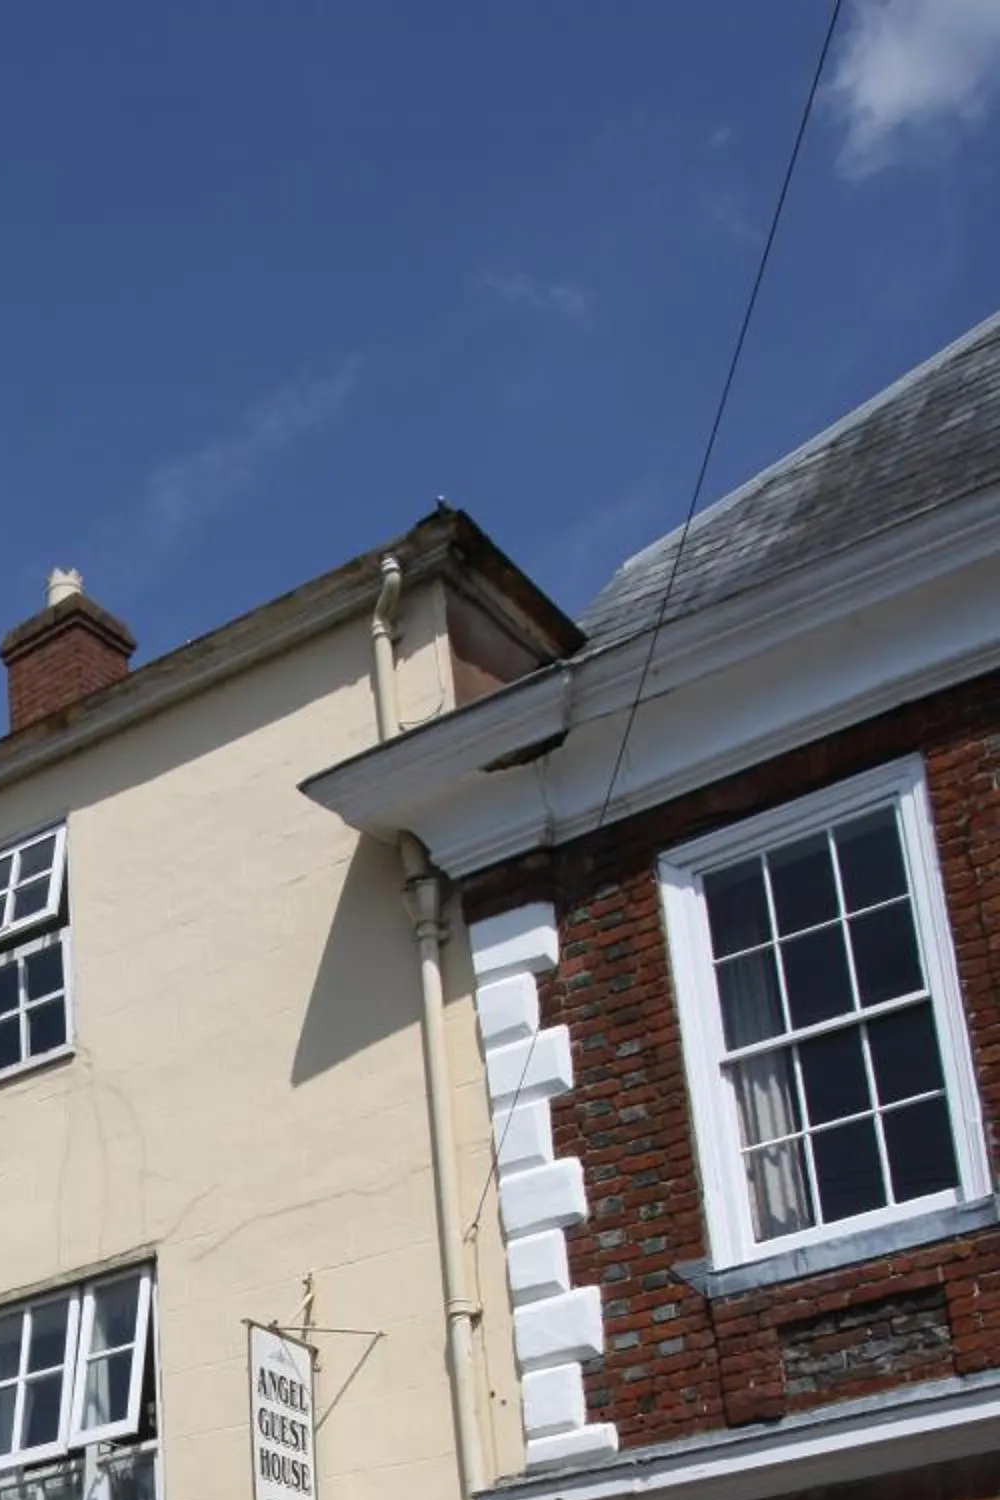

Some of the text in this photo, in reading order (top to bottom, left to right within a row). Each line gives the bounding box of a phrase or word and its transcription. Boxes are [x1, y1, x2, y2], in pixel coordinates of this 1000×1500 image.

[257, 1366, 309, 1414] ANGEL
[257, 1407, 309, 1453] GUEST
[259, 1448, 311, 1495] HOUSE
